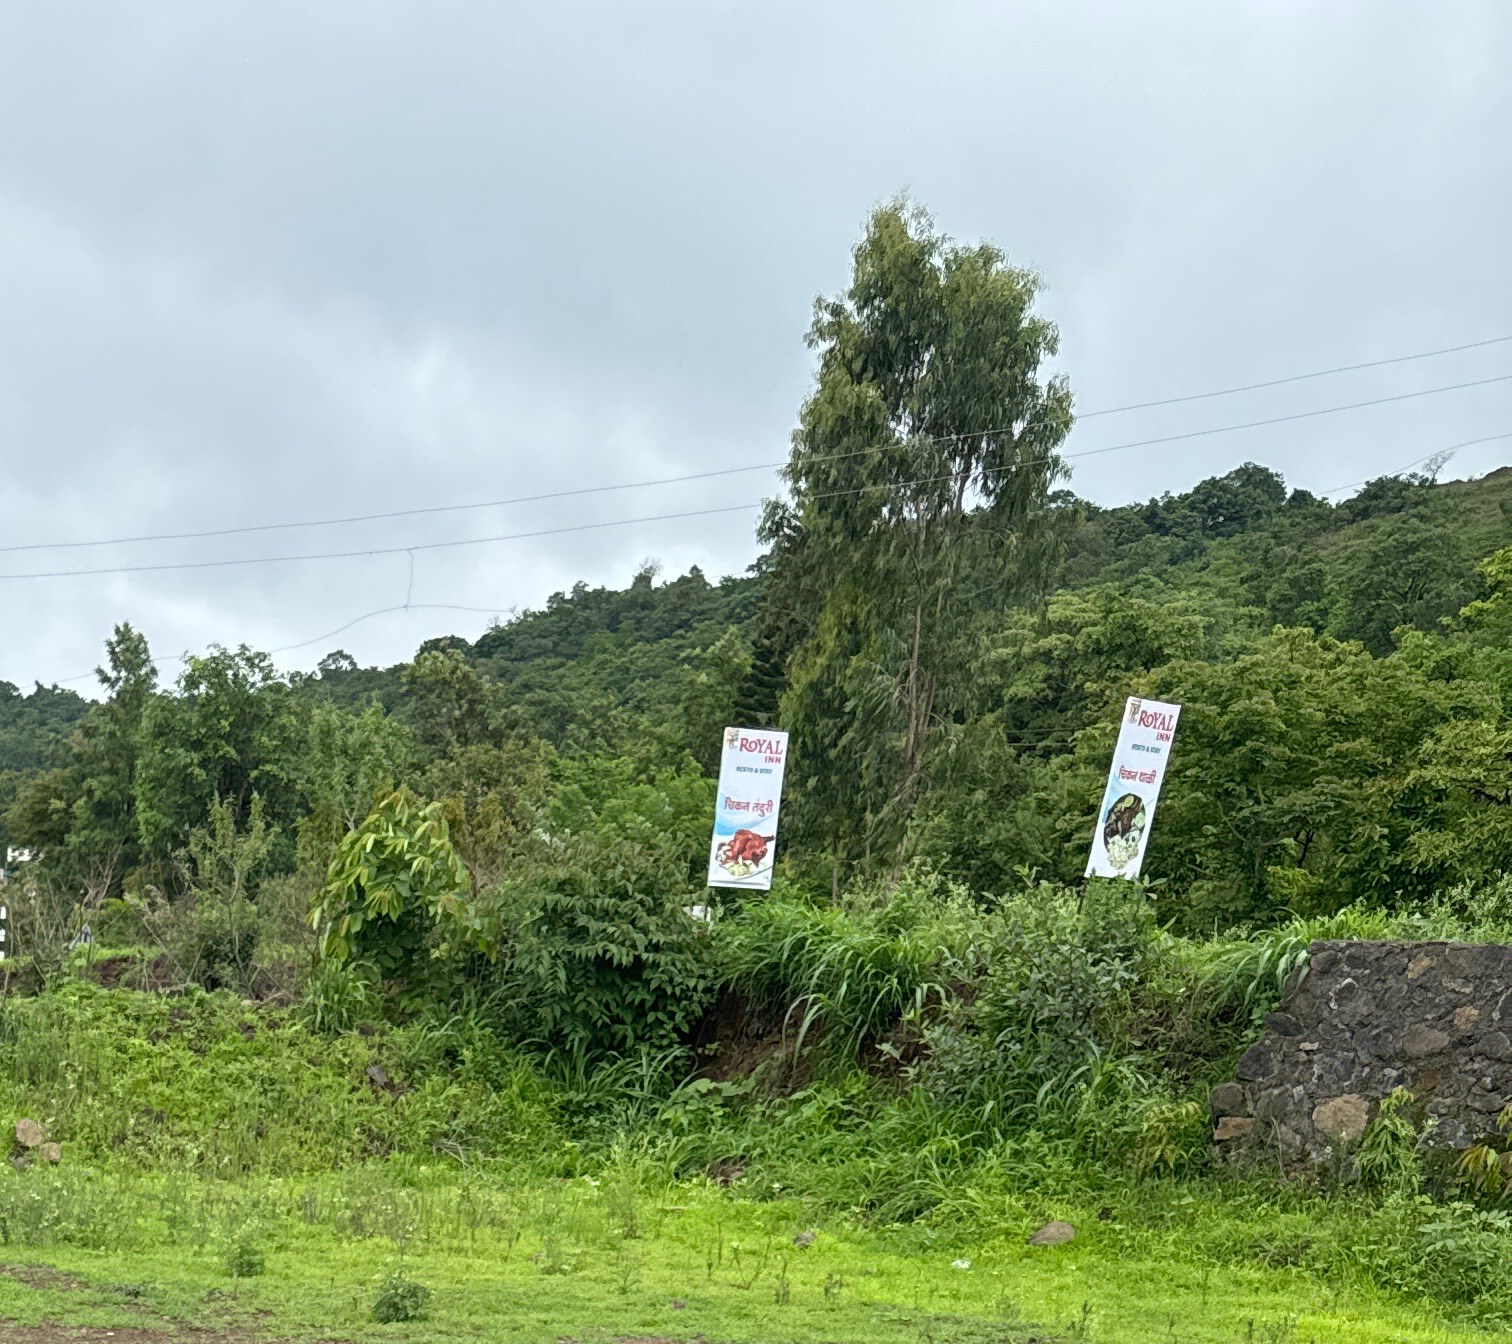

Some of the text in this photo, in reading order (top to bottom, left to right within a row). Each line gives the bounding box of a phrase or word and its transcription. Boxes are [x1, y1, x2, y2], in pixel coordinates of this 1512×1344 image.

[1138, 709, 1175, 731] ROYAL
[739, 737, 784, 755] ROYAL
[764, 756, 782, 764] INN
[724, 796, 750, 812] चिकन
